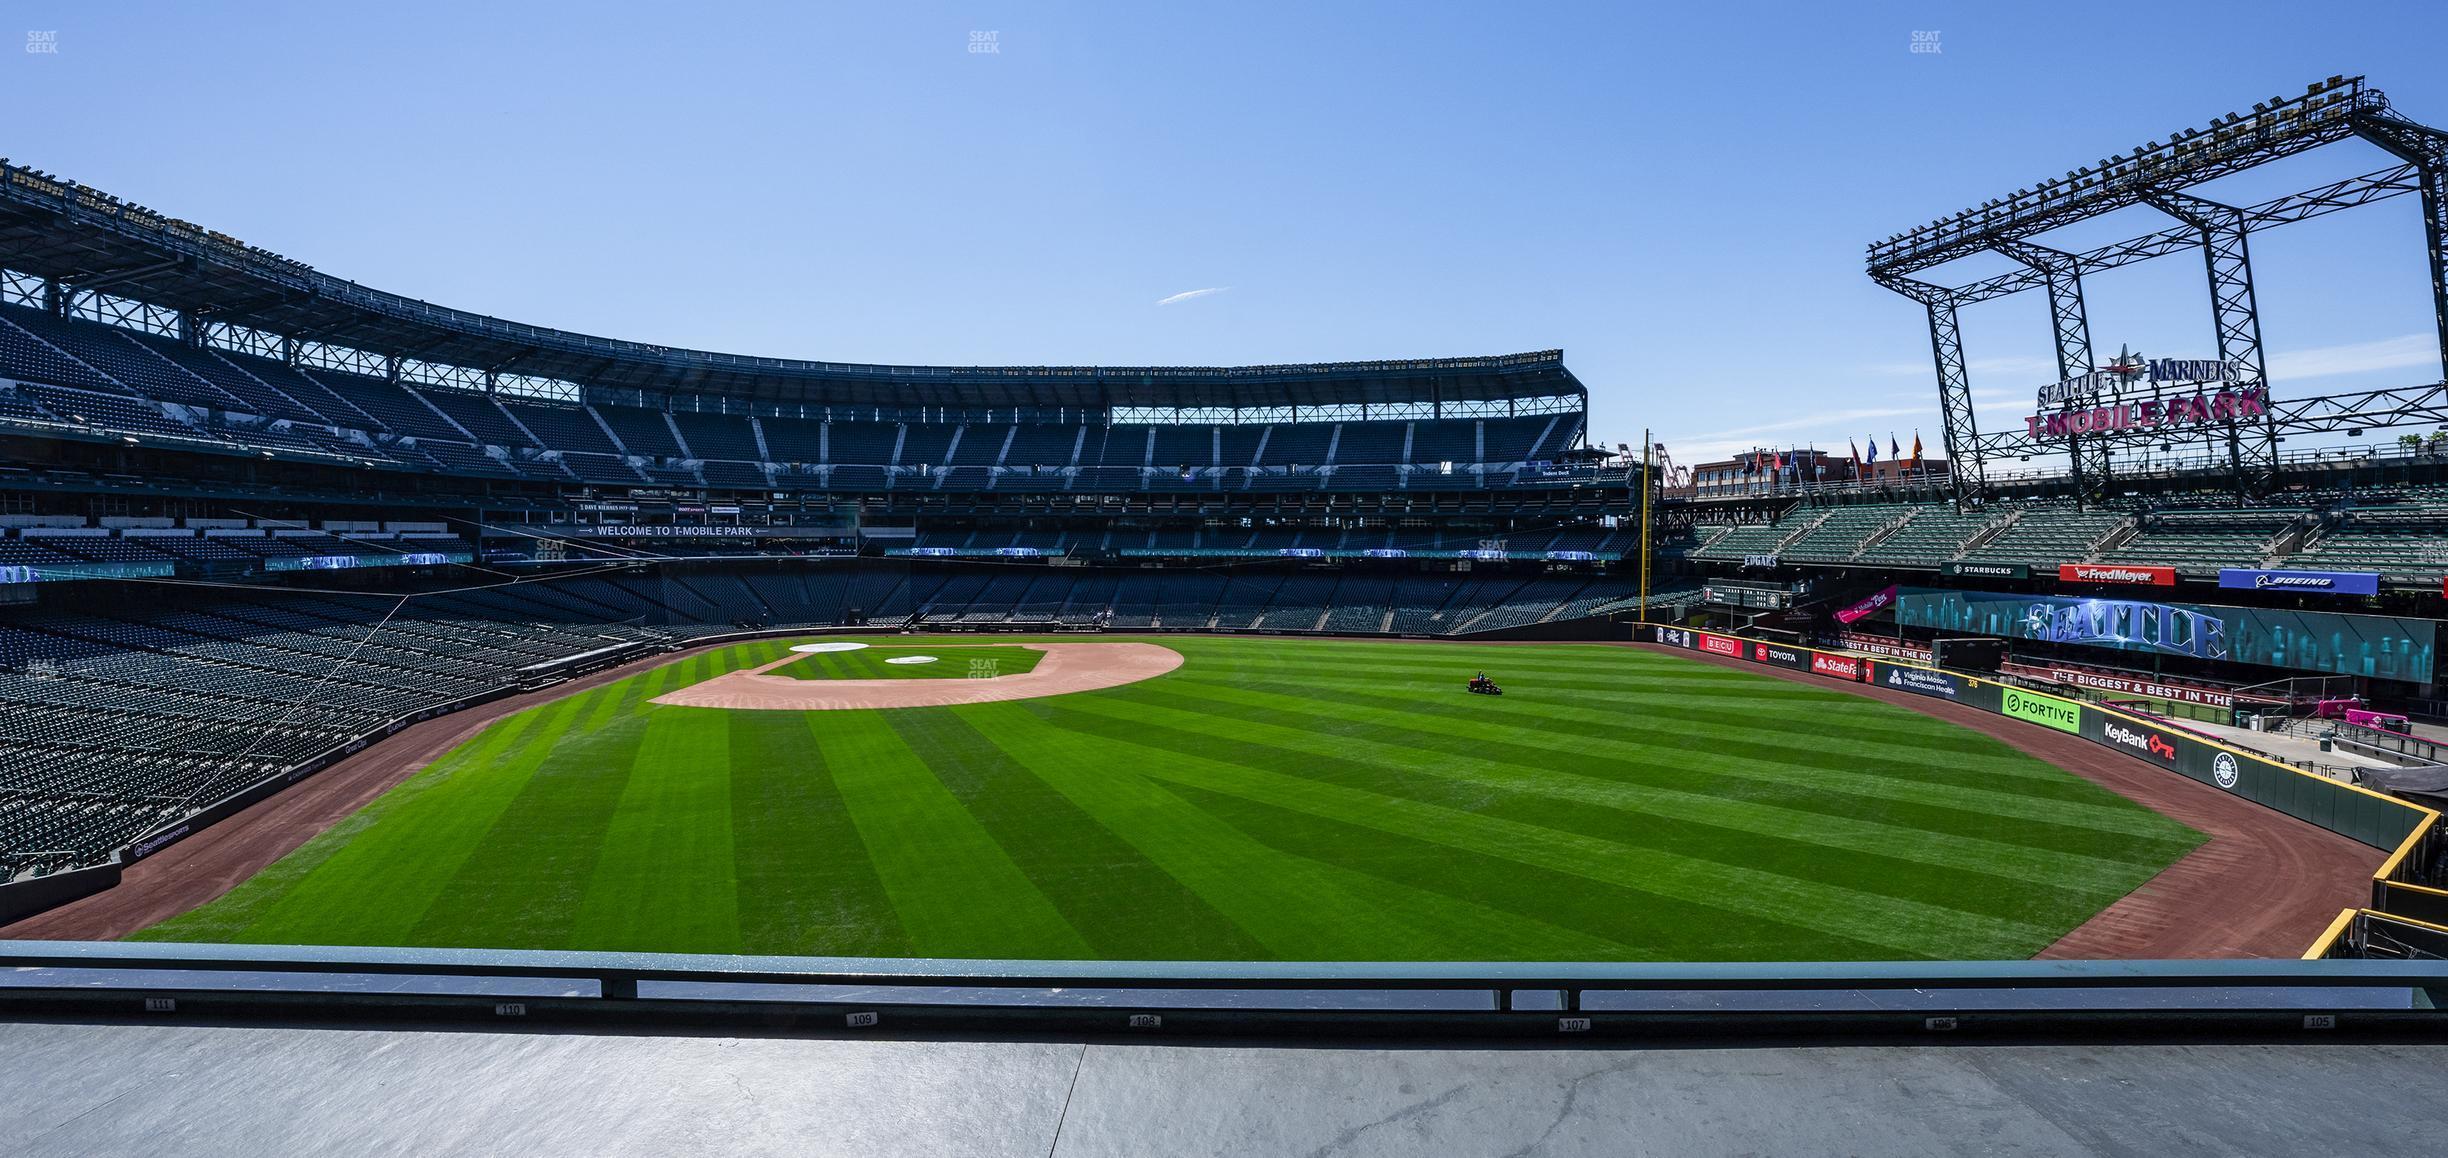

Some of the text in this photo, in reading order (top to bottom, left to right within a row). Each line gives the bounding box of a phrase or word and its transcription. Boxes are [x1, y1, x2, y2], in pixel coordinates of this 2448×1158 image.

[2037, 357, 2241, 409] SEATTLE MARINERS
[2025, 386, 2270, 439] T-MOBILE PARK
[597, 526, 752, 536] WELCOME TO T-MOBILE PARK
[1964, 566, 2011, 574] STARBUCKS
[2273, 576, 2332, 586] BOEING
[1708, 638, 1733, 651] BECU
[1768, 649, 1796, 663] TOYOTA
[1870, 645, 1890, 654] BEST
[1891, 648, 1900, 656] IN
[1902, 650, 1918, 658] THE
[1926, 675, 1948, 685] Mason
[2052, 671, 2231, 706] THE BIGGEST & BEST IN THE
[2022, 700, 2075, 724] FORTIVE
[2105, 722, 2148, 750] KeyBank
[154, 1000, 168, 1009] 111
[503, 1005, 520, 1015] 110
[854, 1015, 872, 1025] 109
[1137, 1016, 1155, 1025] 108
[1566, 1020, 1584, 1030] 107
[2311, 1017, 2329, 1027] 105
